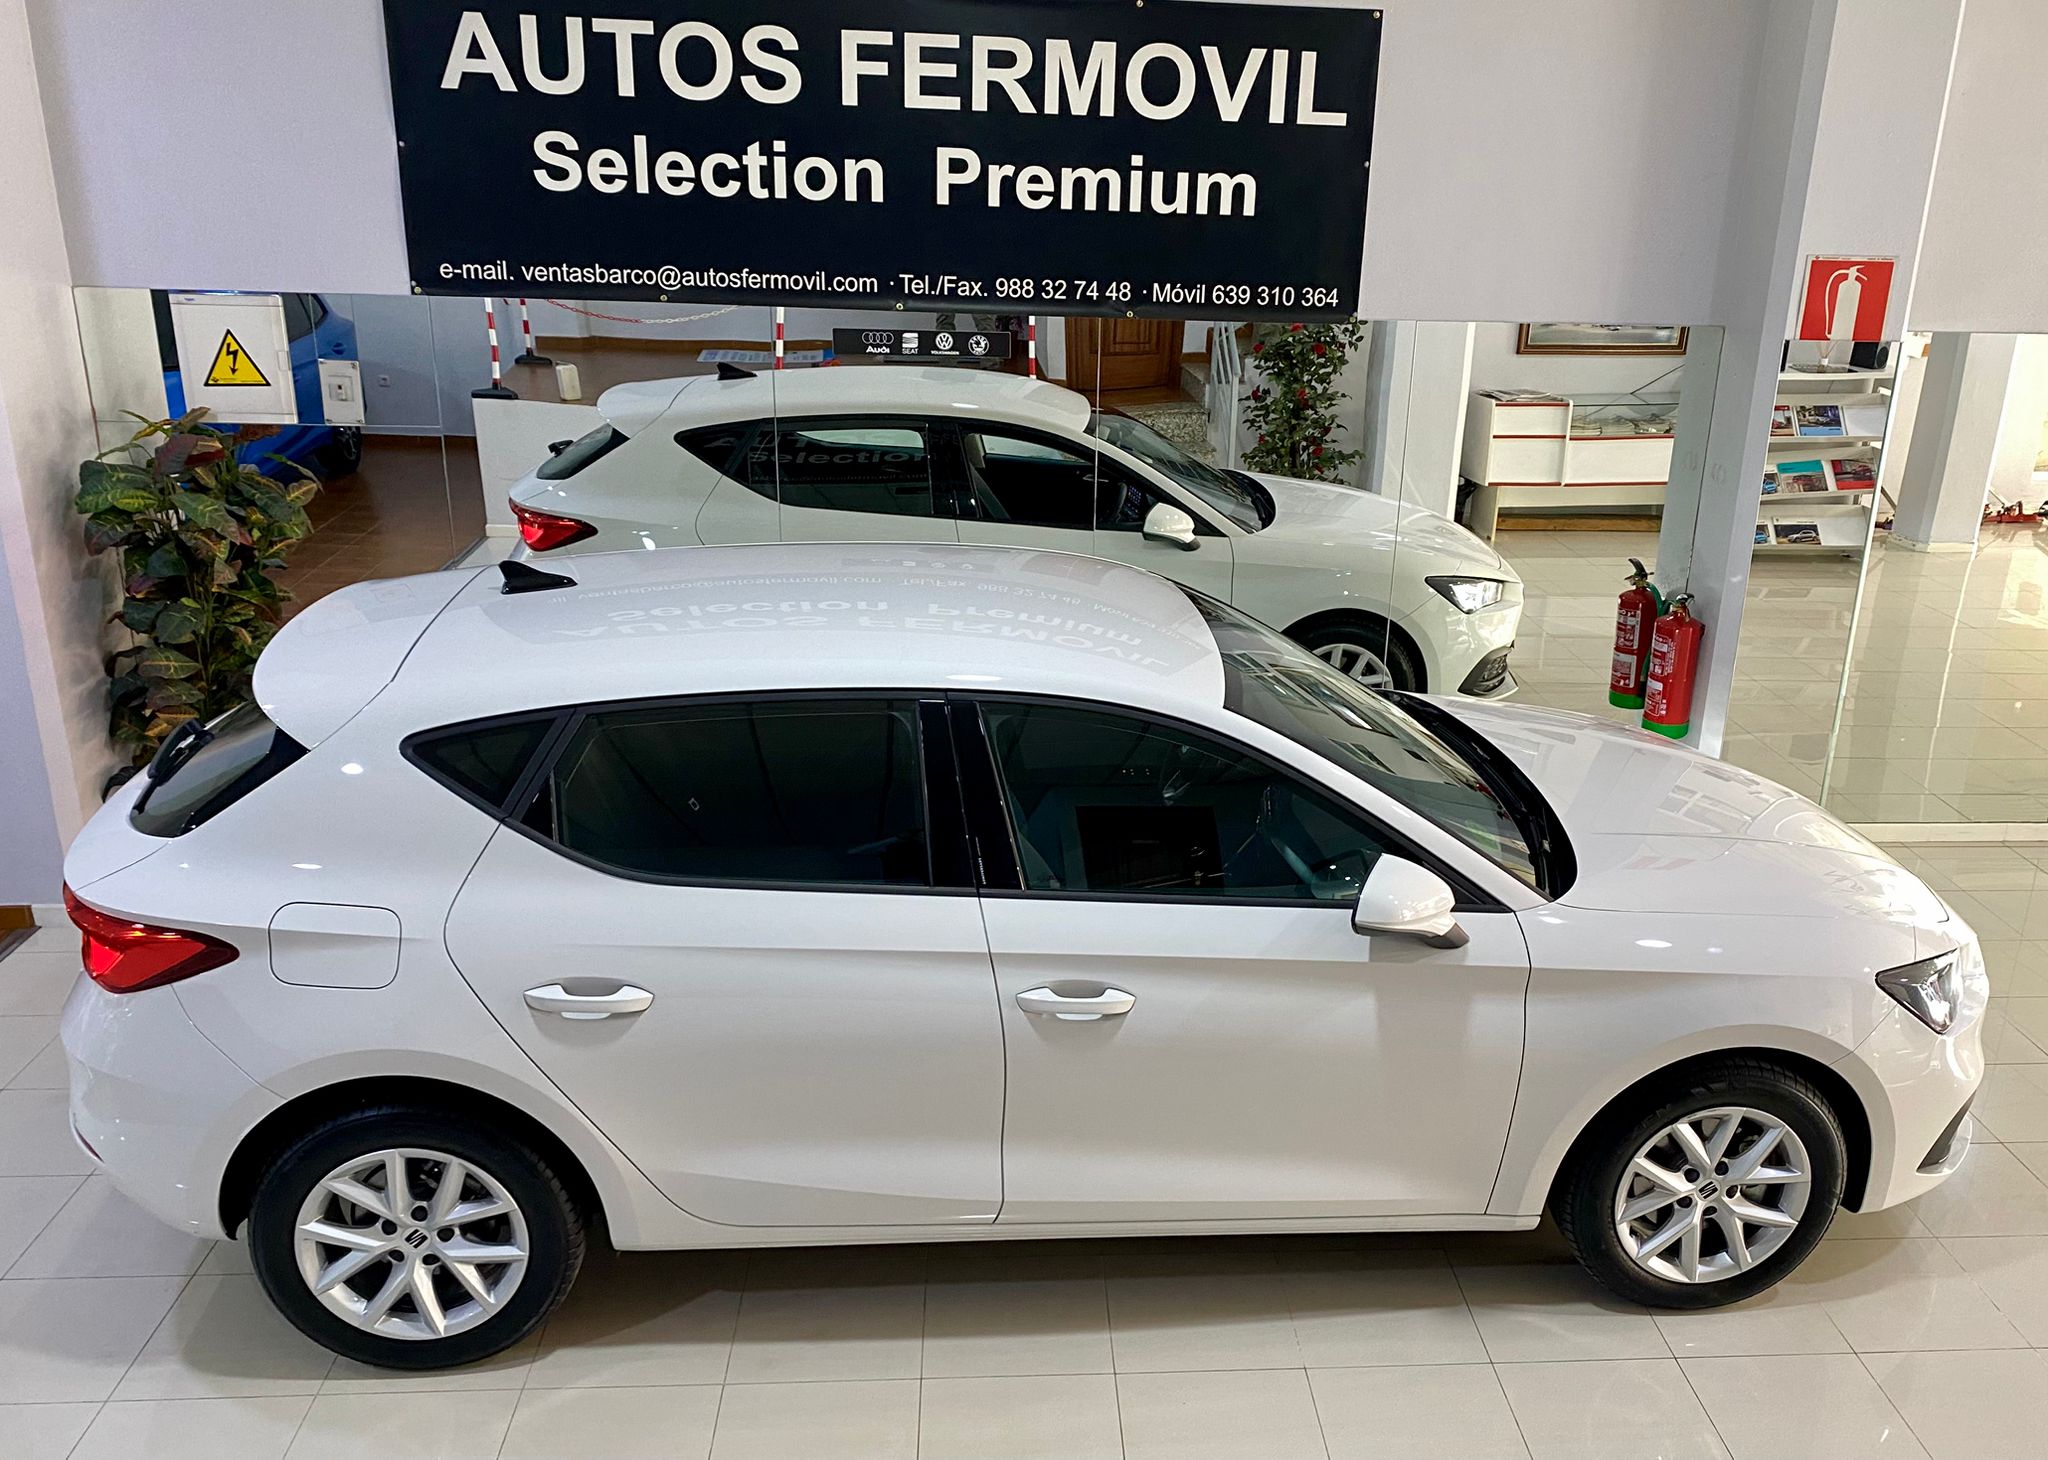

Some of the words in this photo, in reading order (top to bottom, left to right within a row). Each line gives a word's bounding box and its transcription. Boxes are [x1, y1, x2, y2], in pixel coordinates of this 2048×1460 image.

[440, 11, 802, 105] AUTOS
[841, 29, 1348, 127] FERMOVIL
[534, 130, 884, 203] Selection
[937, 147, 1257, 217] Premium
[439, 260, 515, 282] e-mail.
[521, 262, 879, 294] ventasbarco@autosfermovil.com
[996, 277, 1034, 299] 988
[1041, 279, 1067, 300] 32
[1074, 280, 1100, 301] 74
[1105, 281, 1132, 302] 48
[1213, 284, 1251, 306] 639
[1257, 286, 1295, 307] 310
[1302, 286, 1339, 308] 364
[866, 345, 890, 354] Audi
